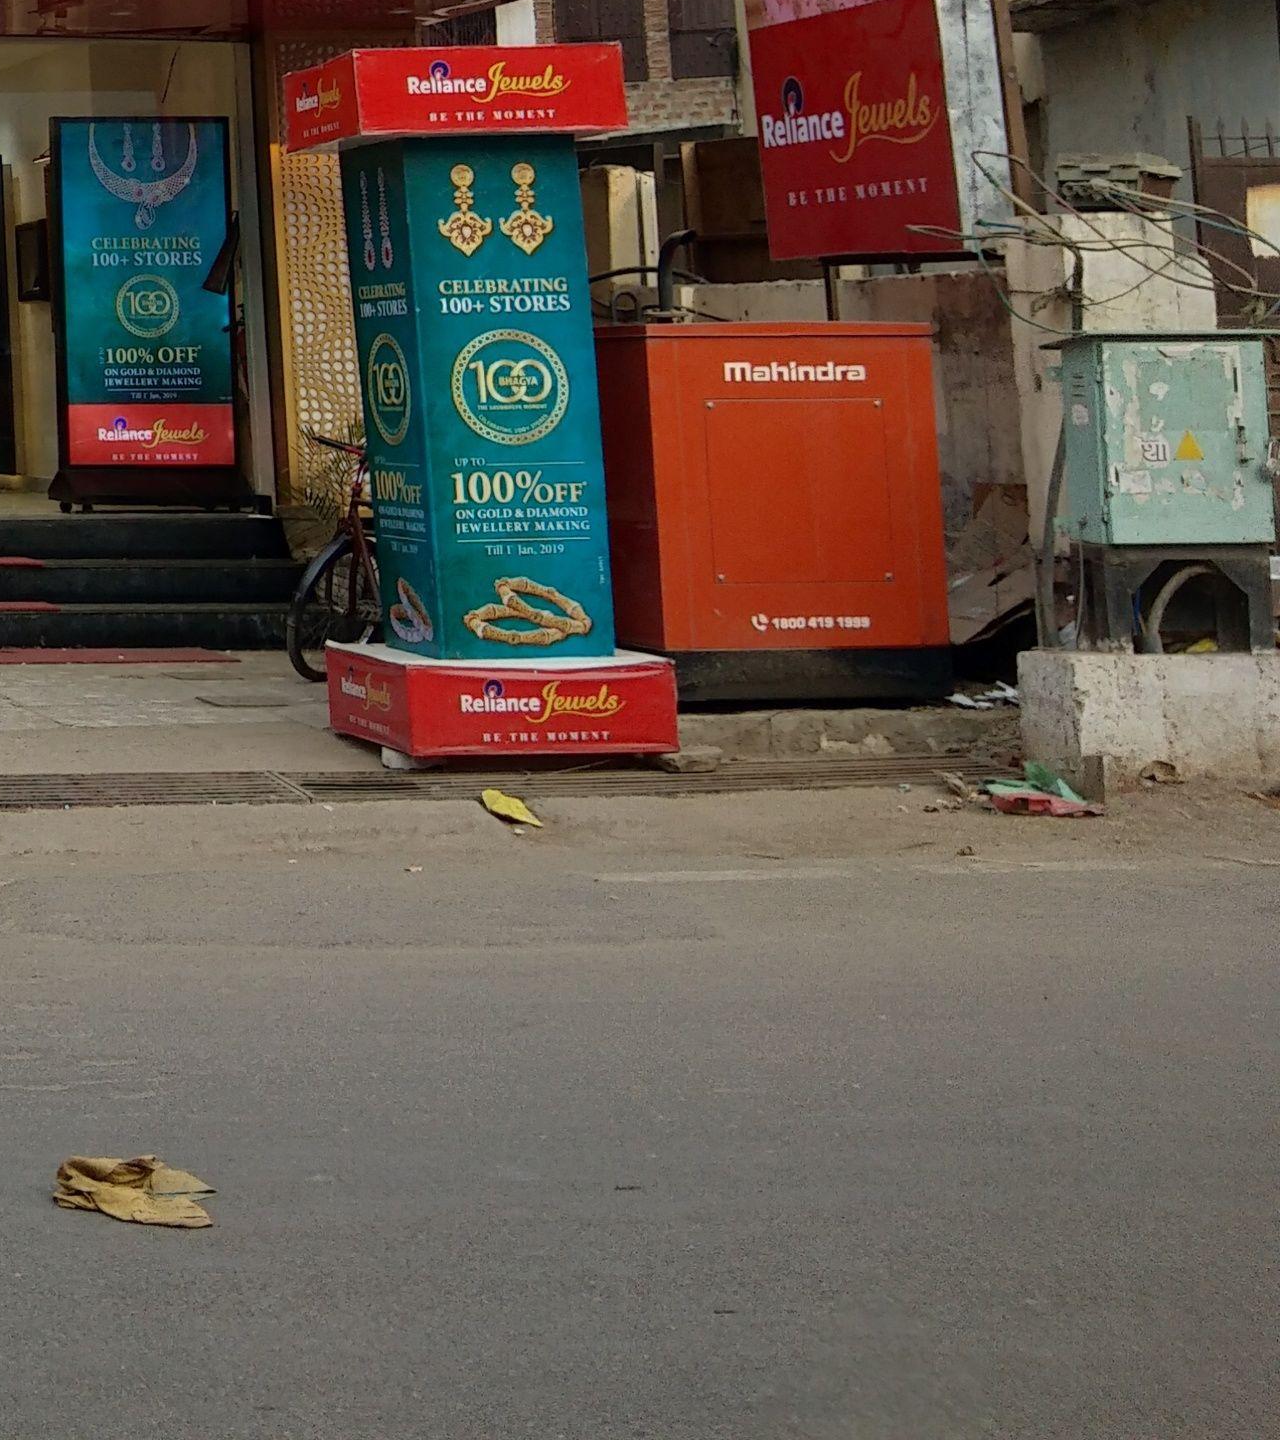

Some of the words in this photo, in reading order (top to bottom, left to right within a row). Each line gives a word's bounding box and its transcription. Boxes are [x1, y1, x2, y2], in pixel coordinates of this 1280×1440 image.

[407, 71, 486, 95] Reliance
[472, 61, 570, 103] Jewels
[429, 112, 448, 122] BE
[456, 110, 485, 122] THE
[493, 109, 556, 121] MOMENT
[761, 101, 844, 148] Reliance
[829, 71, 940, 162] Jewels
[788, 191, 808, 207] BE
[815, 186, 846, 204] THE
[855, 178, 927, 200] MOMENT
[91, 237, 200, 249] CELEBRATING
[92, 253, 129, 266] 100+
[134, 251, 202, 266] STORES
[439, 278, 568, 293] CELEBRATING
[440, 298, 485, 314] 100+
[490, 294, 570, 313] STORES
[106, 348, 154, 364] 100%
[104, 368, 119, 376] ON
[120, 368, 146, 376] GOLD
[724, 361, 867, 382] Mahindra
[104, 378, 159, 387] JEWELLERY
[469, 359, 552, 403] 100
[98, 424, 152, 441] Reliance
[140, 419, 209, 448] Jewels
[455, 458, 468, 467] UP
[471, 458, 485, 466] TO
[451, 470, 542, 504] 100%
[455, 509, 474, 519] ON
[477, 509, 512, 519] GOLD
[514, 508, 524, 518] &
[527, 507, 588, 517] DIAMOND
[456, 522, 530, 534] JEWELLERY
[535, 520, 590, 532] MAKING
[485, 545, 502, 555] Till
[540, 544, 564, 554] 2019
[771, 617, 806, 630] 1800
[808, 616, 834, 629] 419
[460, 689, 540, 713] Reliance
[525, 681, 626, 723] Jewels
[482, 732, 500, 743] BE
[509, 732, 538, 743] THE
[546, 731, 610, 742] MOMENT
